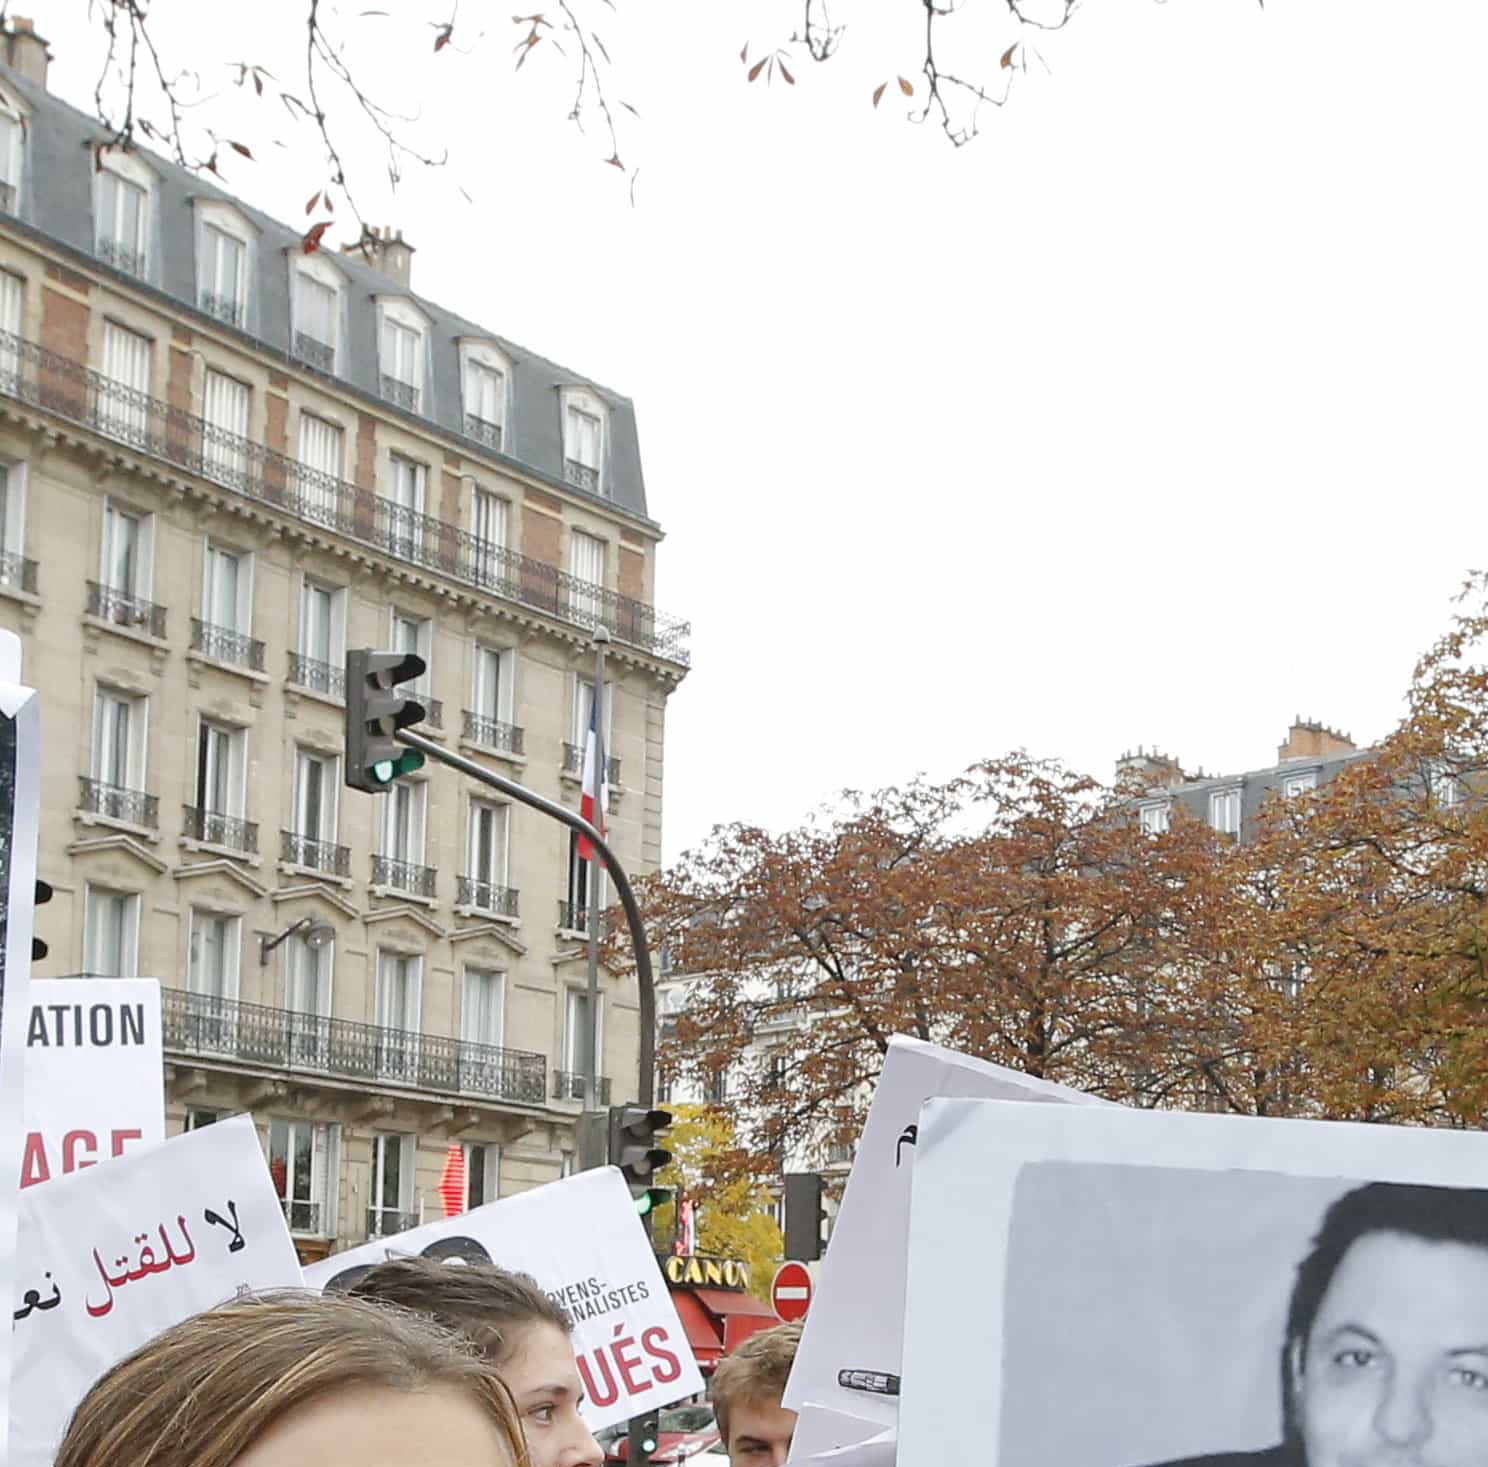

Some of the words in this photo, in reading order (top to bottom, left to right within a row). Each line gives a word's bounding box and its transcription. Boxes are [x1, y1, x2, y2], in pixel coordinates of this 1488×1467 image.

[26, 1003, 145, 1047] ATION
[204, 1200, 246, 1253] لا
[86, 1215, 196, 1318] للقتل
